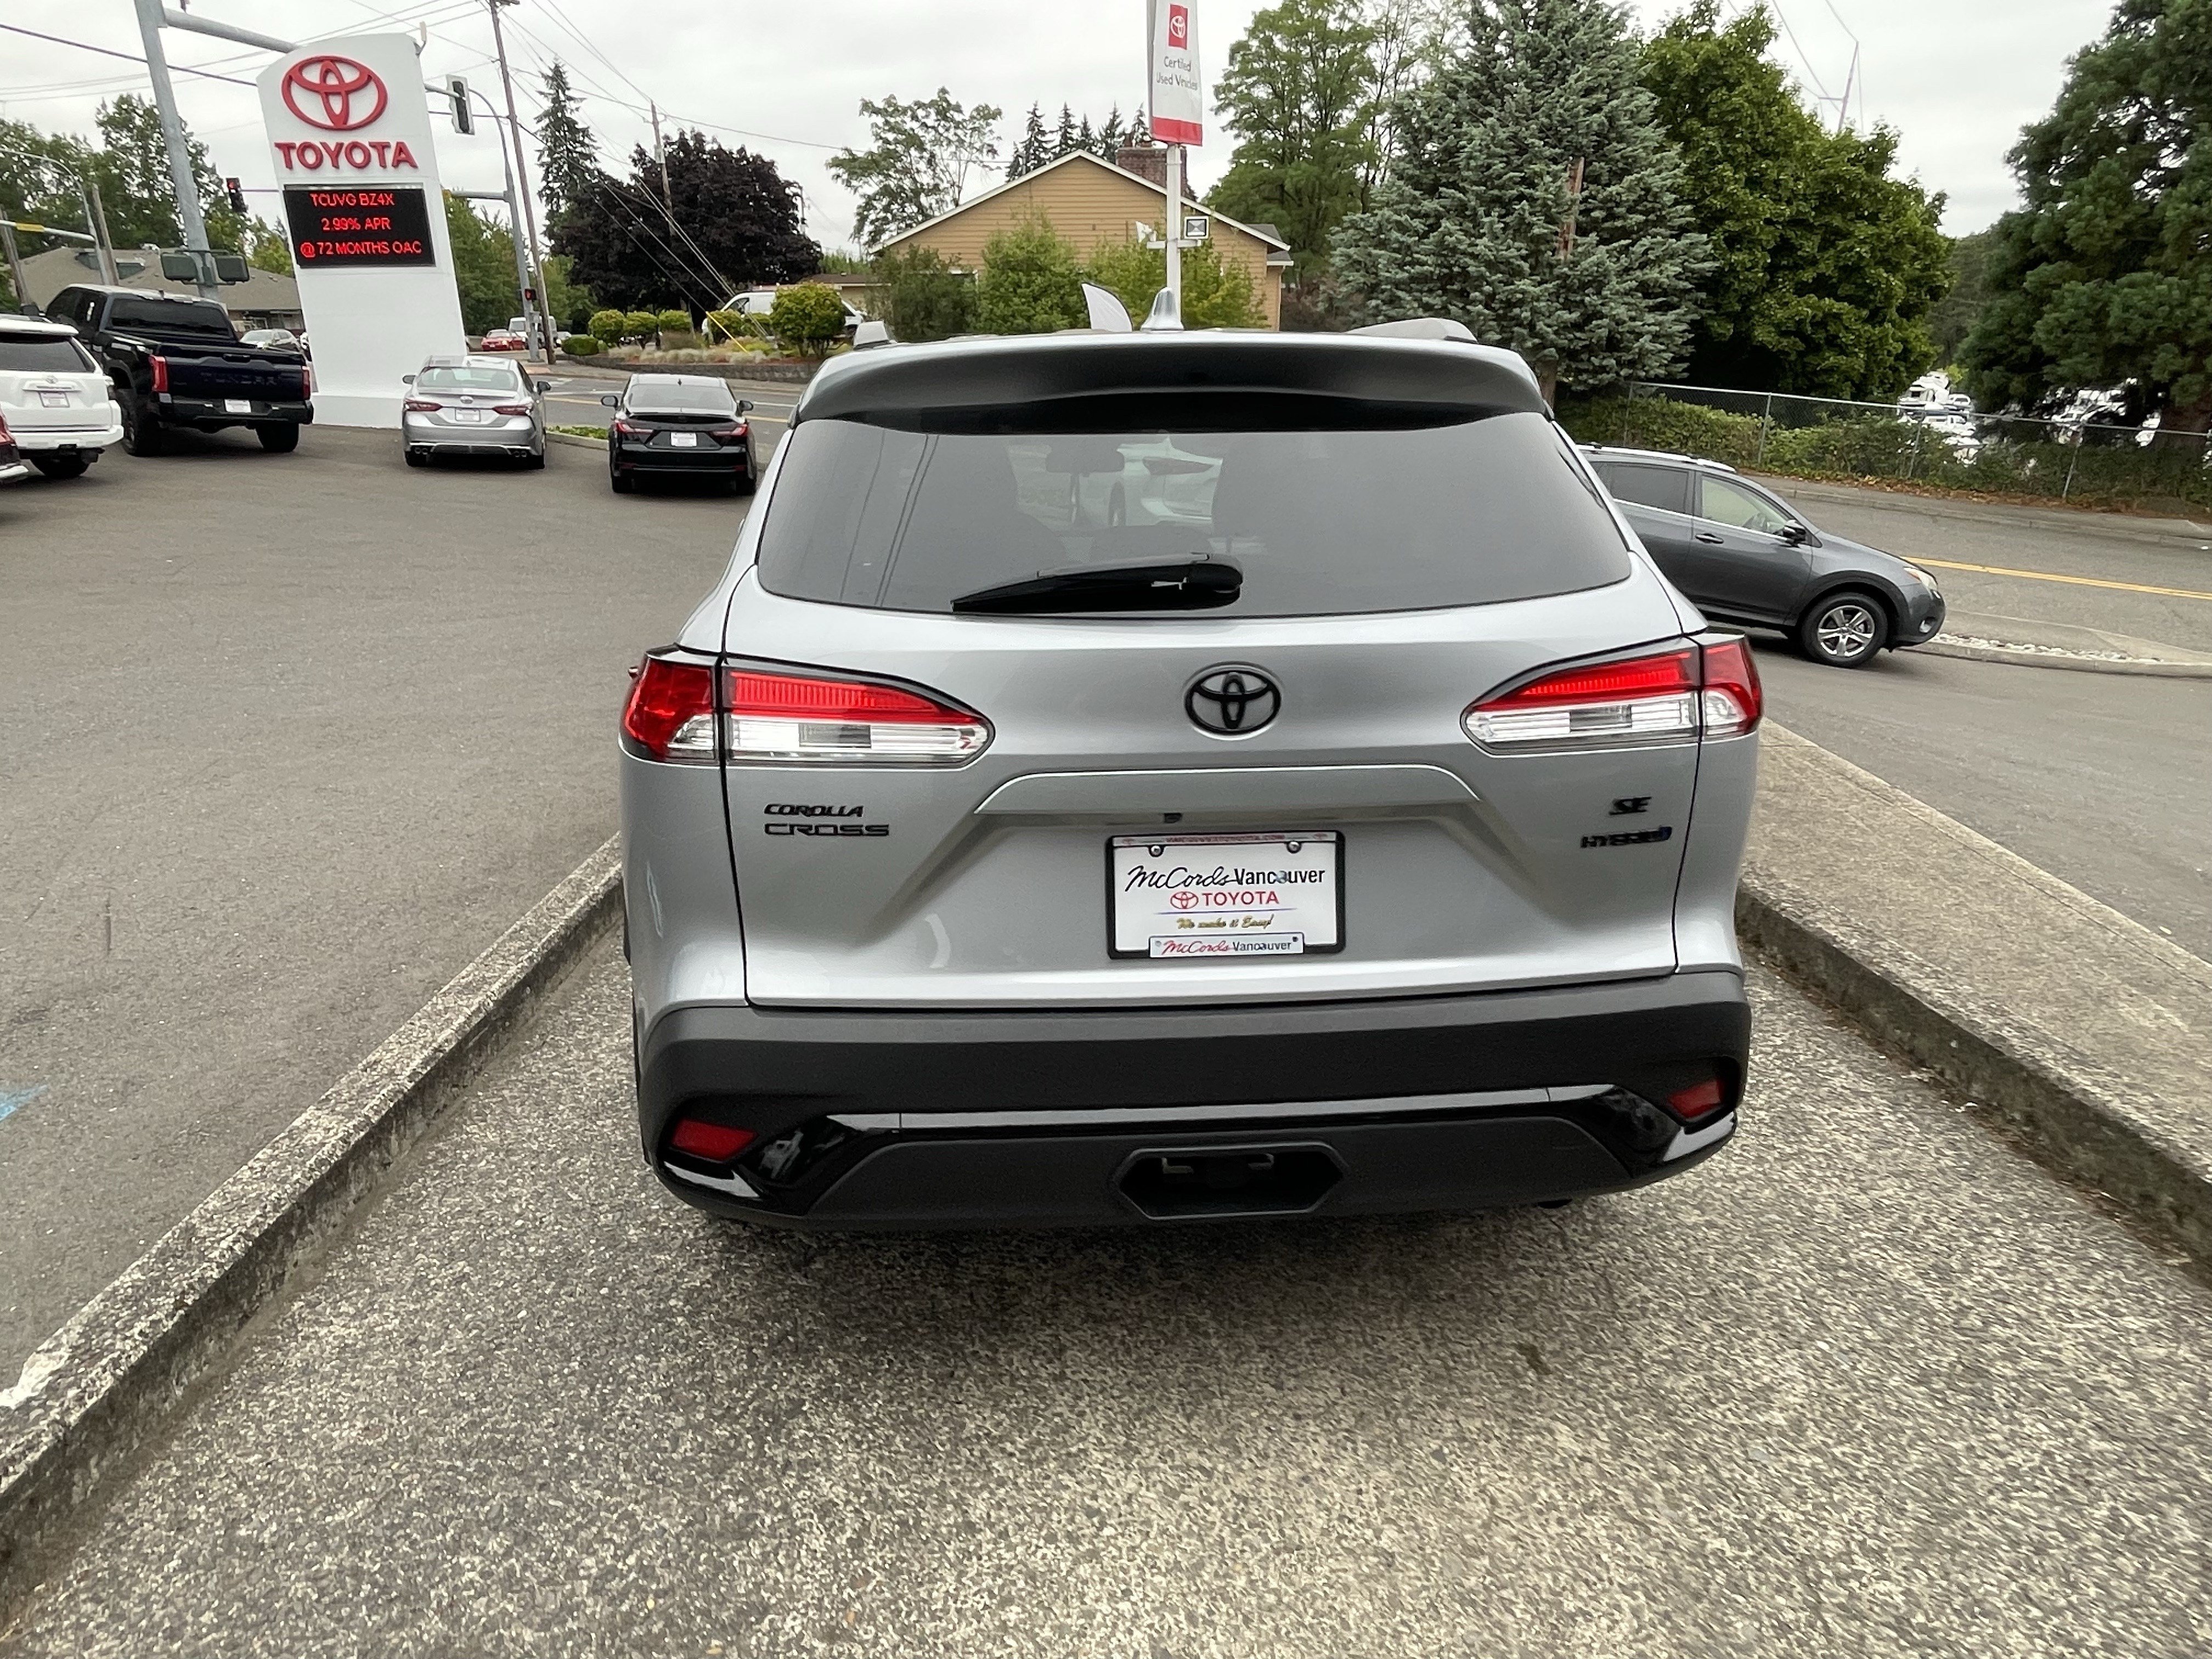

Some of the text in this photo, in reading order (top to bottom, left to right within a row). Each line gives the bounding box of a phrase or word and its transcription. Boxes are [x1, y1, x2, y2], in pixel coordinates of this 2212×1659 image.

[1156, 72, 1173, 86] Used
[274, 141, 419, 170] TOYOTA
[309, 193, 395, 206] TCUVG BZ4X
[321, 217, 392, 230] 2.99% APR
[317, 242, 334, 255] 72
[335, 241, 390, 255] MONTHS
[392, 240, 422, 253] OAC
[764, 804, 864, 817] COROLLA
[764, 823, 890, 836] CROSS
[1125, 865, 1325, 891] McCords Vancouver
[1201, 890, 1280, 906] TOYOTA
[1161, 939, 1232, 955] McCords
